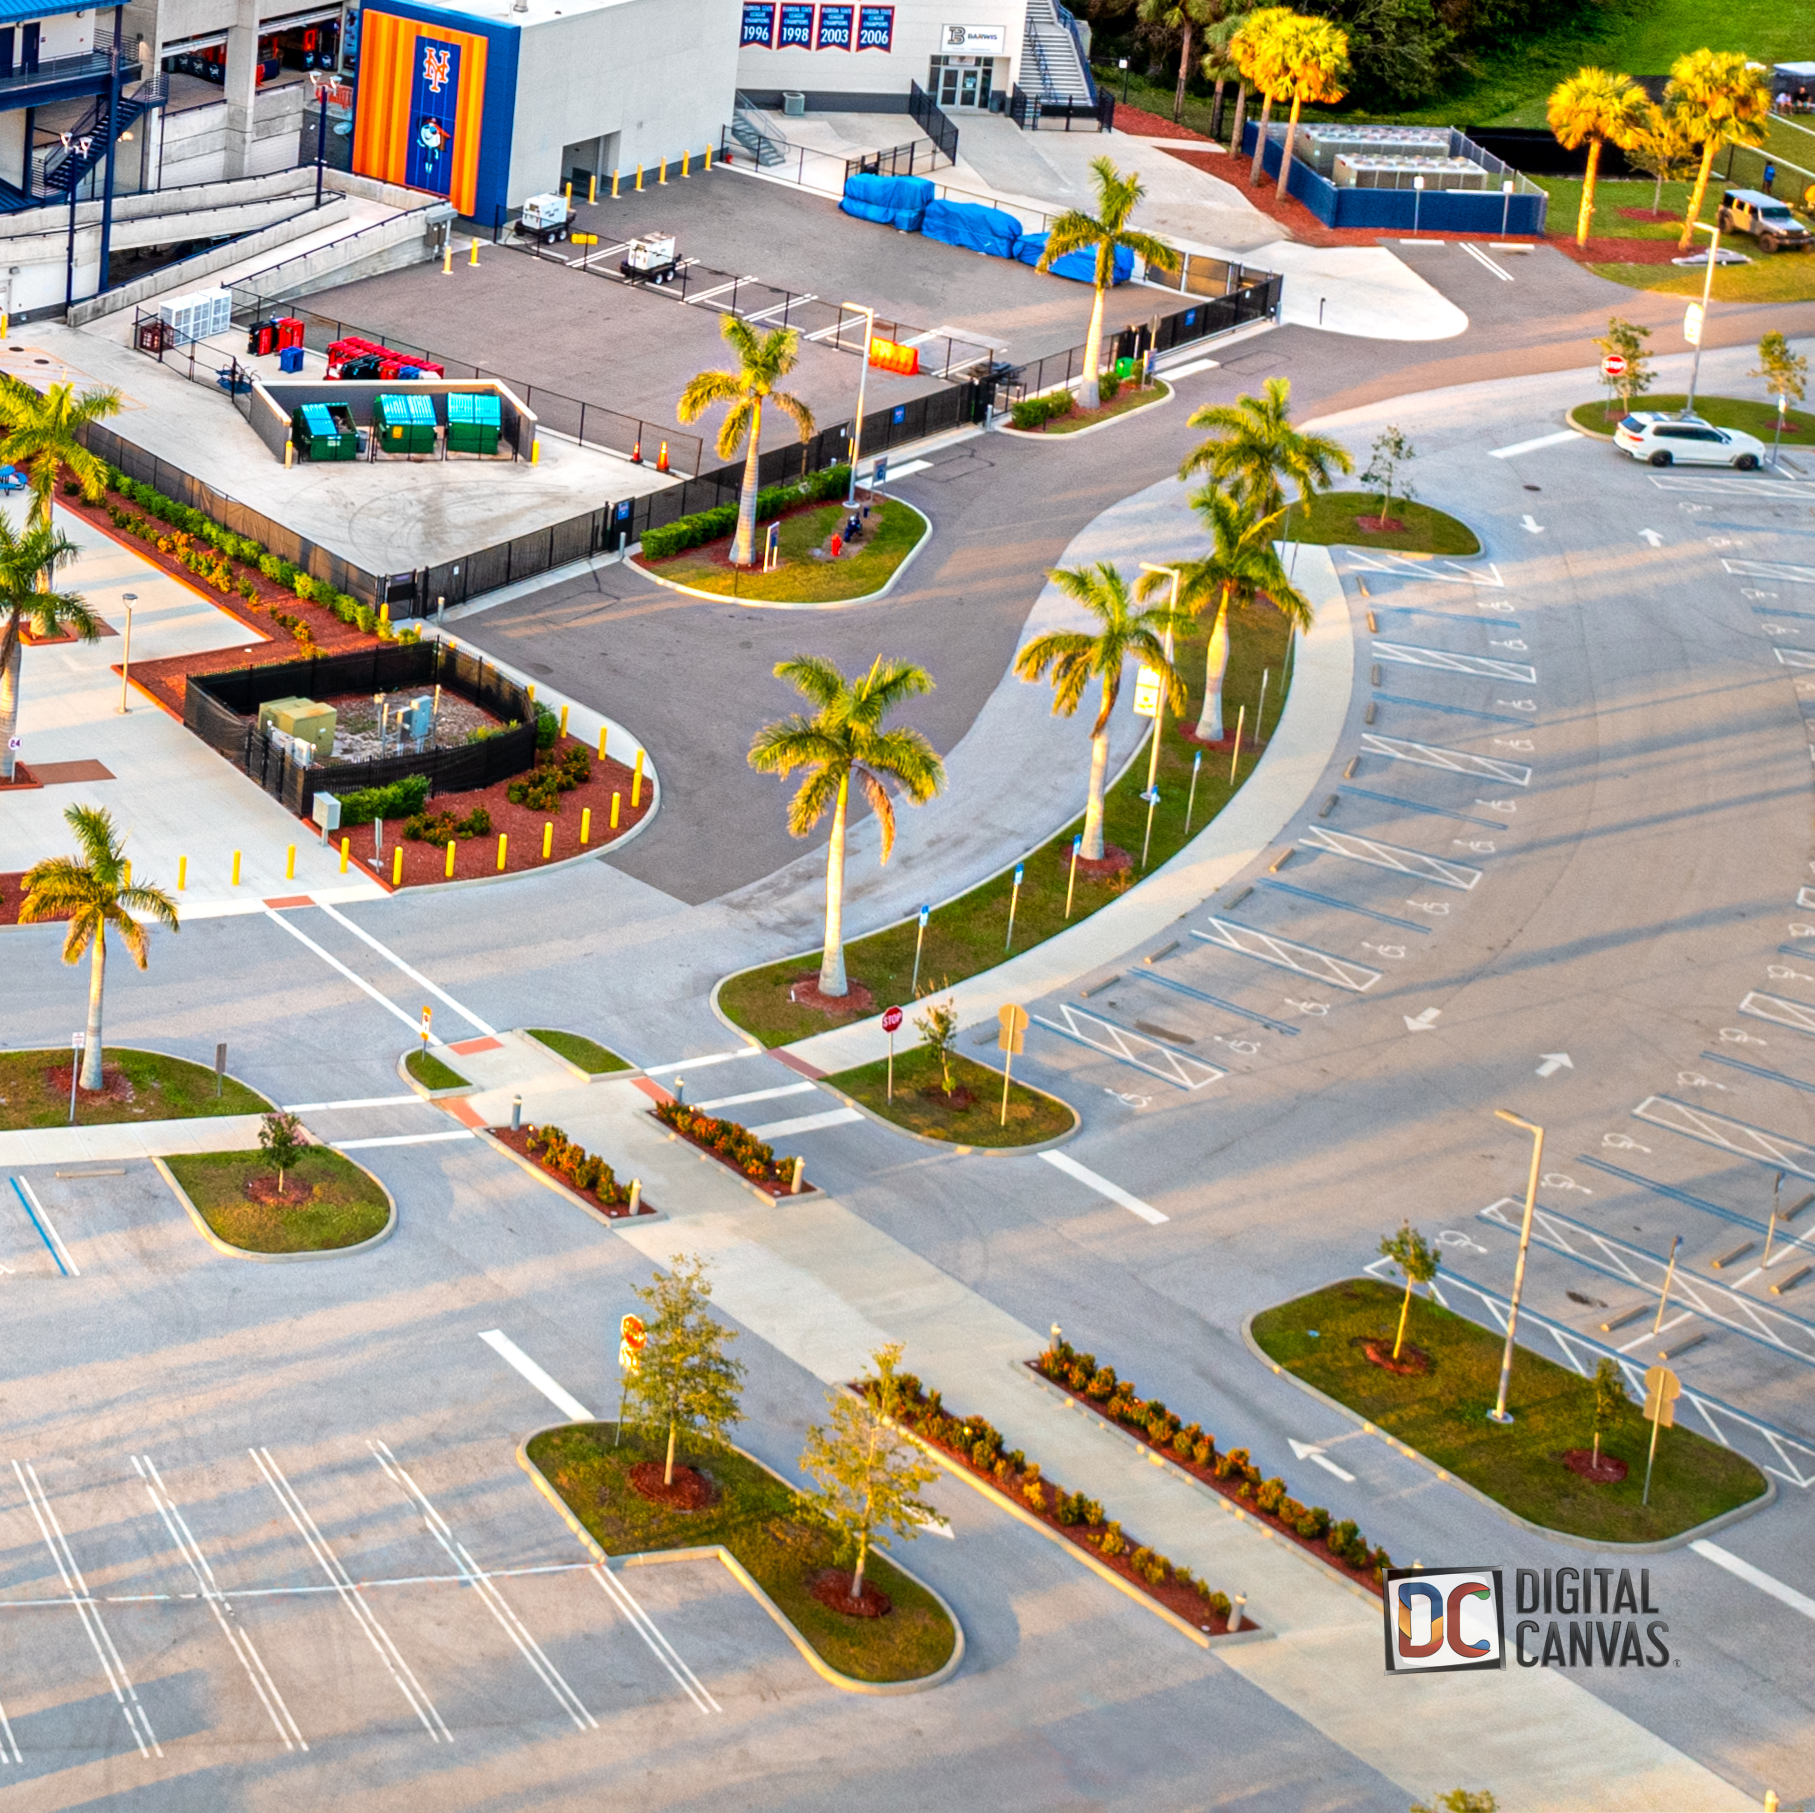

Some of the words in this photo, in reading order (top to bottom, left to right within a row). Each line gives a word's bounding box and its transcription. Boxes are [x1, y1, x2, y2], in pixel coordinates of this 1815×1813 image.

[743, 25, 769, 41] 1996
[782, 27, 810, 42] 1998
[820, 28, 849, 43] 2003
[860, 29, 889, 45] 2006
[882, 1009, 903, 1027] STOP
